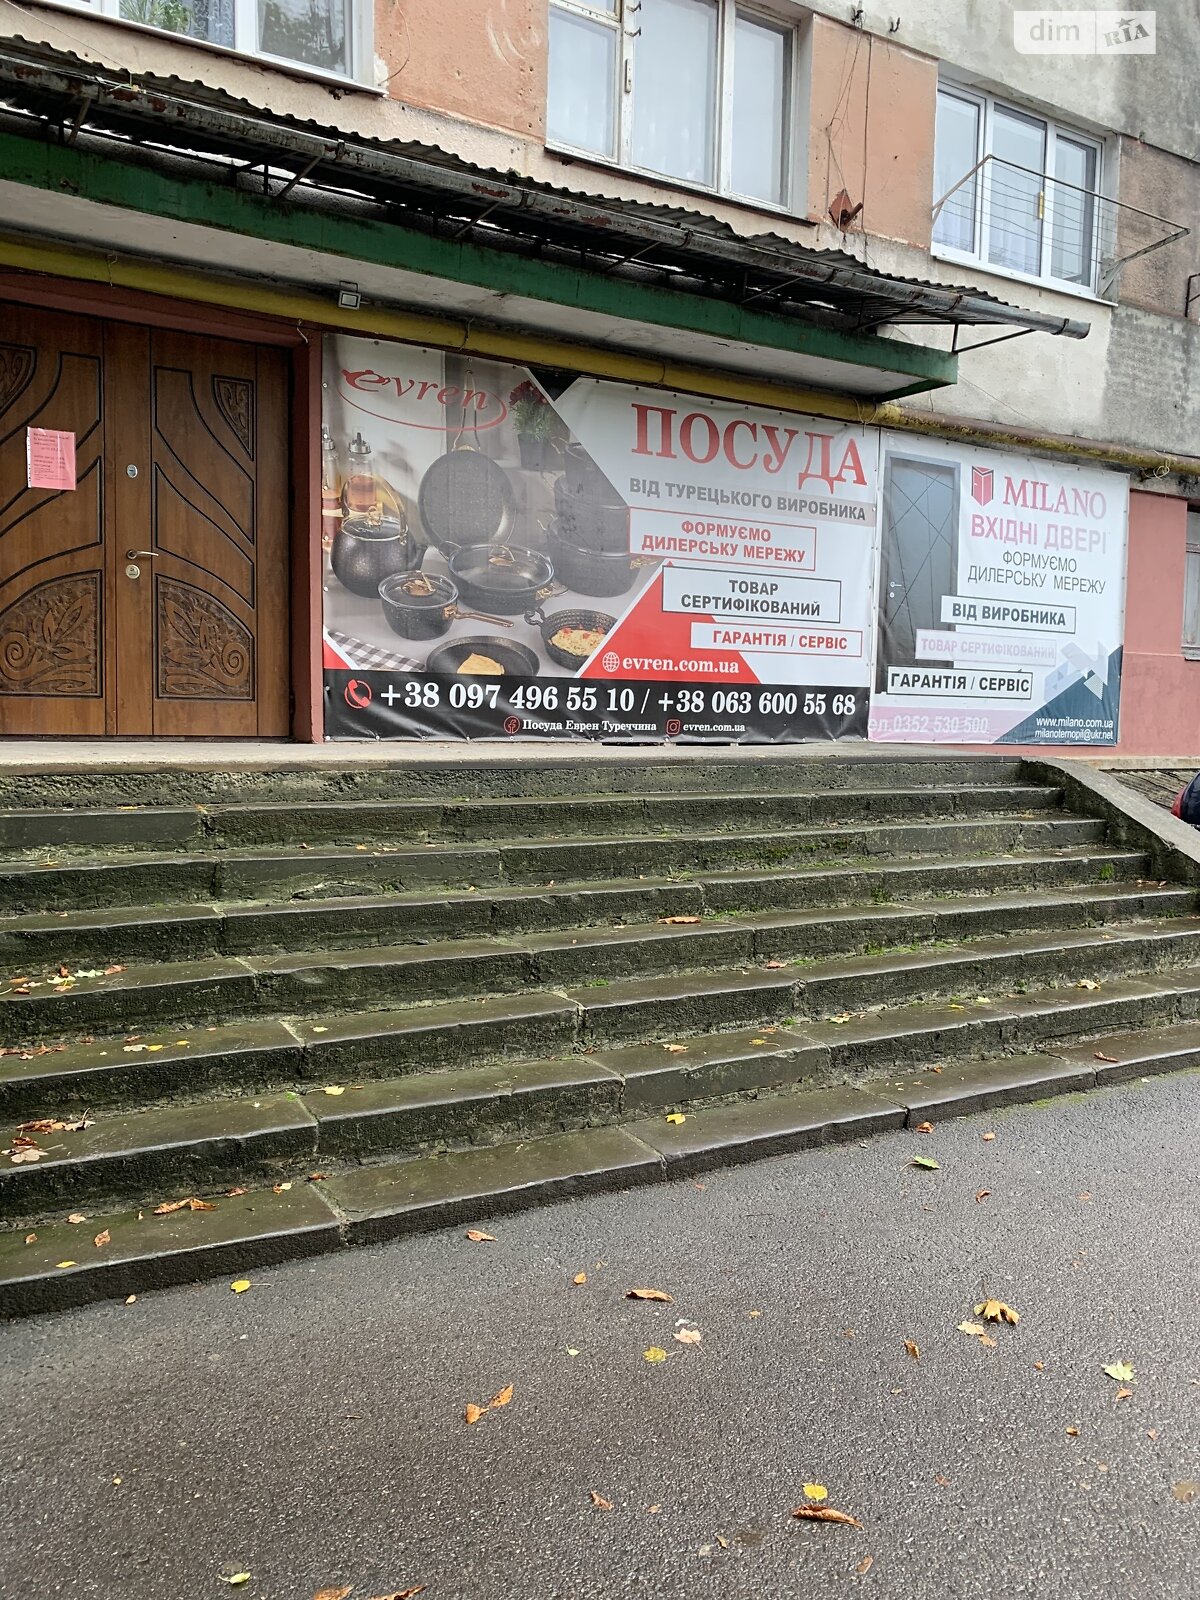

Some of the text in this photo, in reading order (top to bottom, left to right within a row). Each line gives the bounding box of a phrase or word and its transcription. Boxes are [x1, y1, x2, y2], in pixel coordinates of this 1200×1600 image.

[341, 369, 488, 411] evren
[631, 403, 868, 495] ПОСУДА
[630, 477, 866, 521] ВІД ТУРЕЦЬКОГО ВИРОБНИКА
[1002, 475, 1107, 520] MILANO
[681, 520, 771, 542] ФОРМУЄМО
[971, 514, 1107, 554] ВХІДНІ ДВЕРІ
[641, 534, 806, 563] ДИЛЕРСЬКУ МЕРЕЖУ
[1003, 550, 1077, 573] ФОРМУЄМО
[729, 579, 779, 596] ТОВАР
[967, 565, 1106, 595] ДИЛЕРСЬКУ МЕРЕЖУ
[681, 594, 820, 617] СЕРТИФІКОВАНИЙ
[952, 602, 1066, 626] ВІД ВИРОБНИКА
[713, 630, 786, 647] ГАРАНТІЯ
[799, 634, 848, 650] СЕРВІС
[921, 638, 957, 652] ТОВАР
[622, 656, 740, 674] evren.com.ua
[891, 673, 967, 690] ГАРАНТІЯ
[979, 677, 1030, 693] СЕРВІС
[380, 682, 440, 708] +38
[449, 683, 501, 709] 097
[509, 685, 559, 710] 496
[566, 687, 598, 711] 55
[606, 687, 635, 712] 10
[658, 689, 705, 713] +38
[711, 690, 752, 715] 063
[758, 692, 798, 715] 600
[803, 693, 827, 715] 55
[832, 693, 856, 716] 68
[522, 720, 657, 733] Посуда Еврен Туреччина
[683, 722, 746, 732] evren.com.ua
[932, 716, 960, 734] 530
[1036, 716, 1114, 728] www.milano.com.ua
